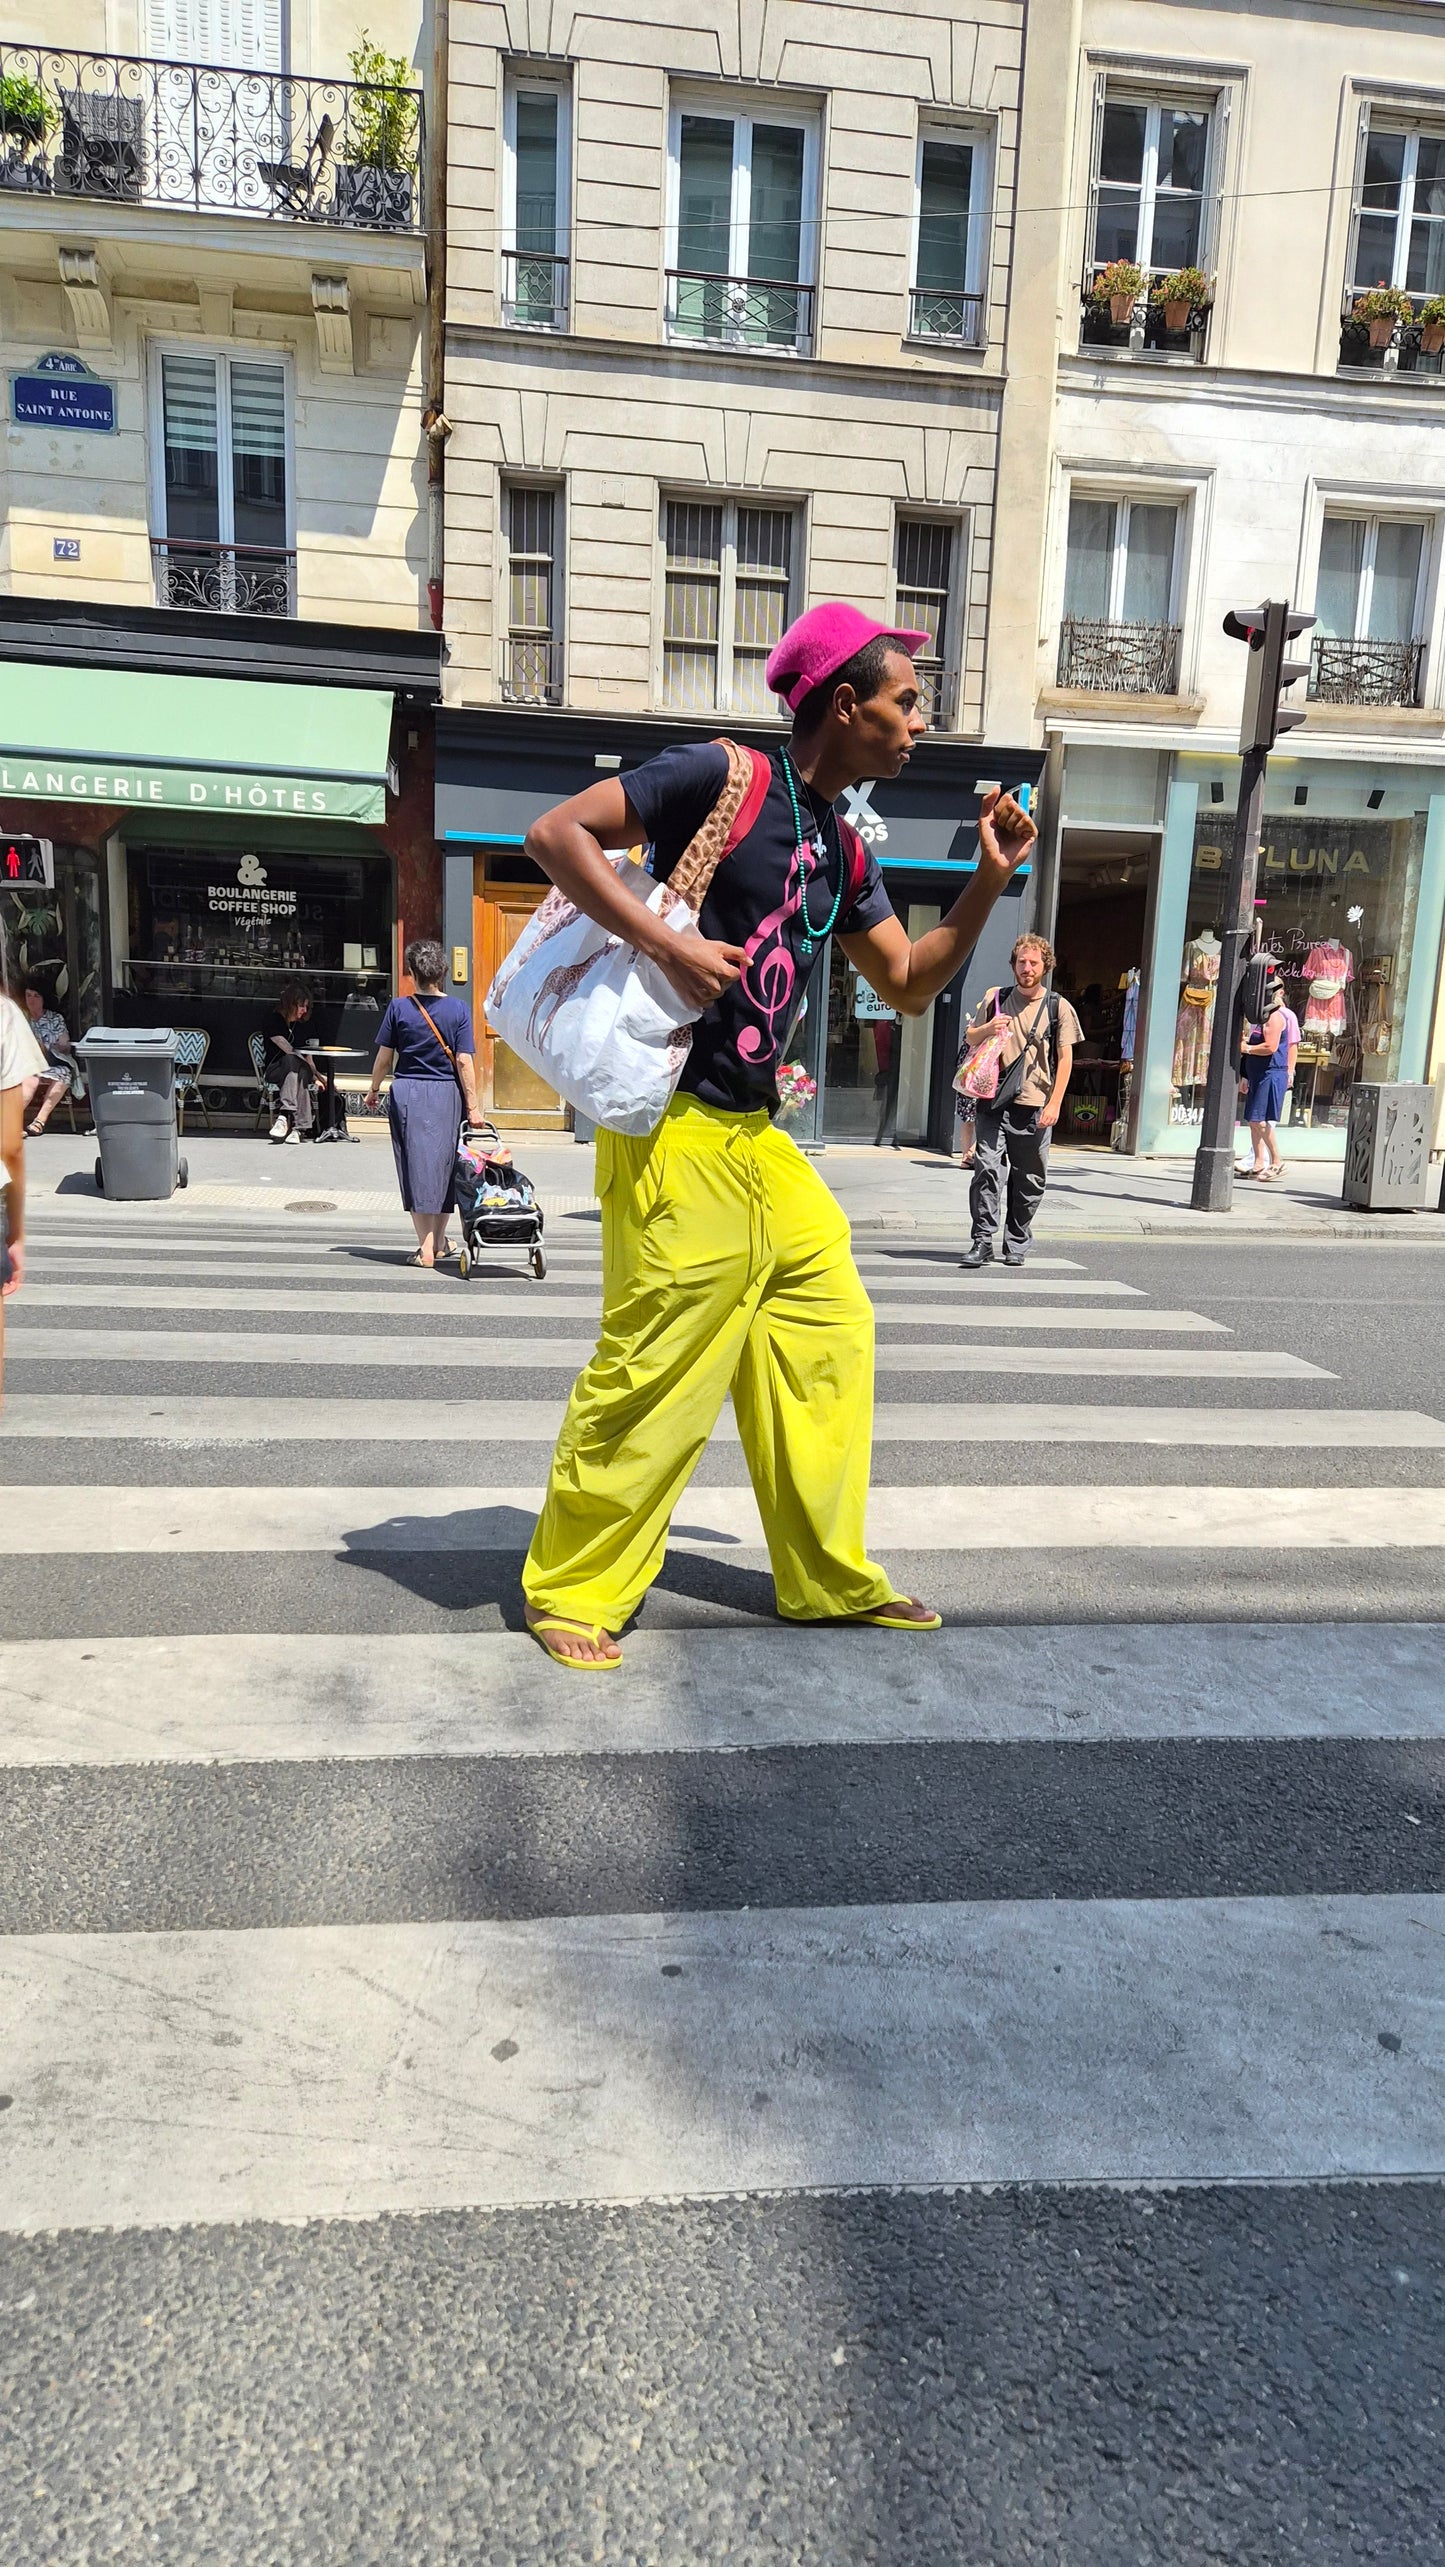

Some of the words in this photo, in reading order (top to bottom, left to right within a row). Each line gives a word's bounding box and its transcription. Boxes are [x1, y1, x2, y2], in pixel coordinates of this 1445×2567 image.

[50, 388, 78, 401] RUE
[17, 403, 54, 416] SAINT
[58, 407, 112, 421] ANTOINE
[56, 540, 78, 556] 72
[190, 783, 327, 811] D'HÔTES
[207, 886, 297, 902] BOULANGERIE
[208, 900, 258, 913] COFFEE
[260, 902, 297, 915] SHOP
